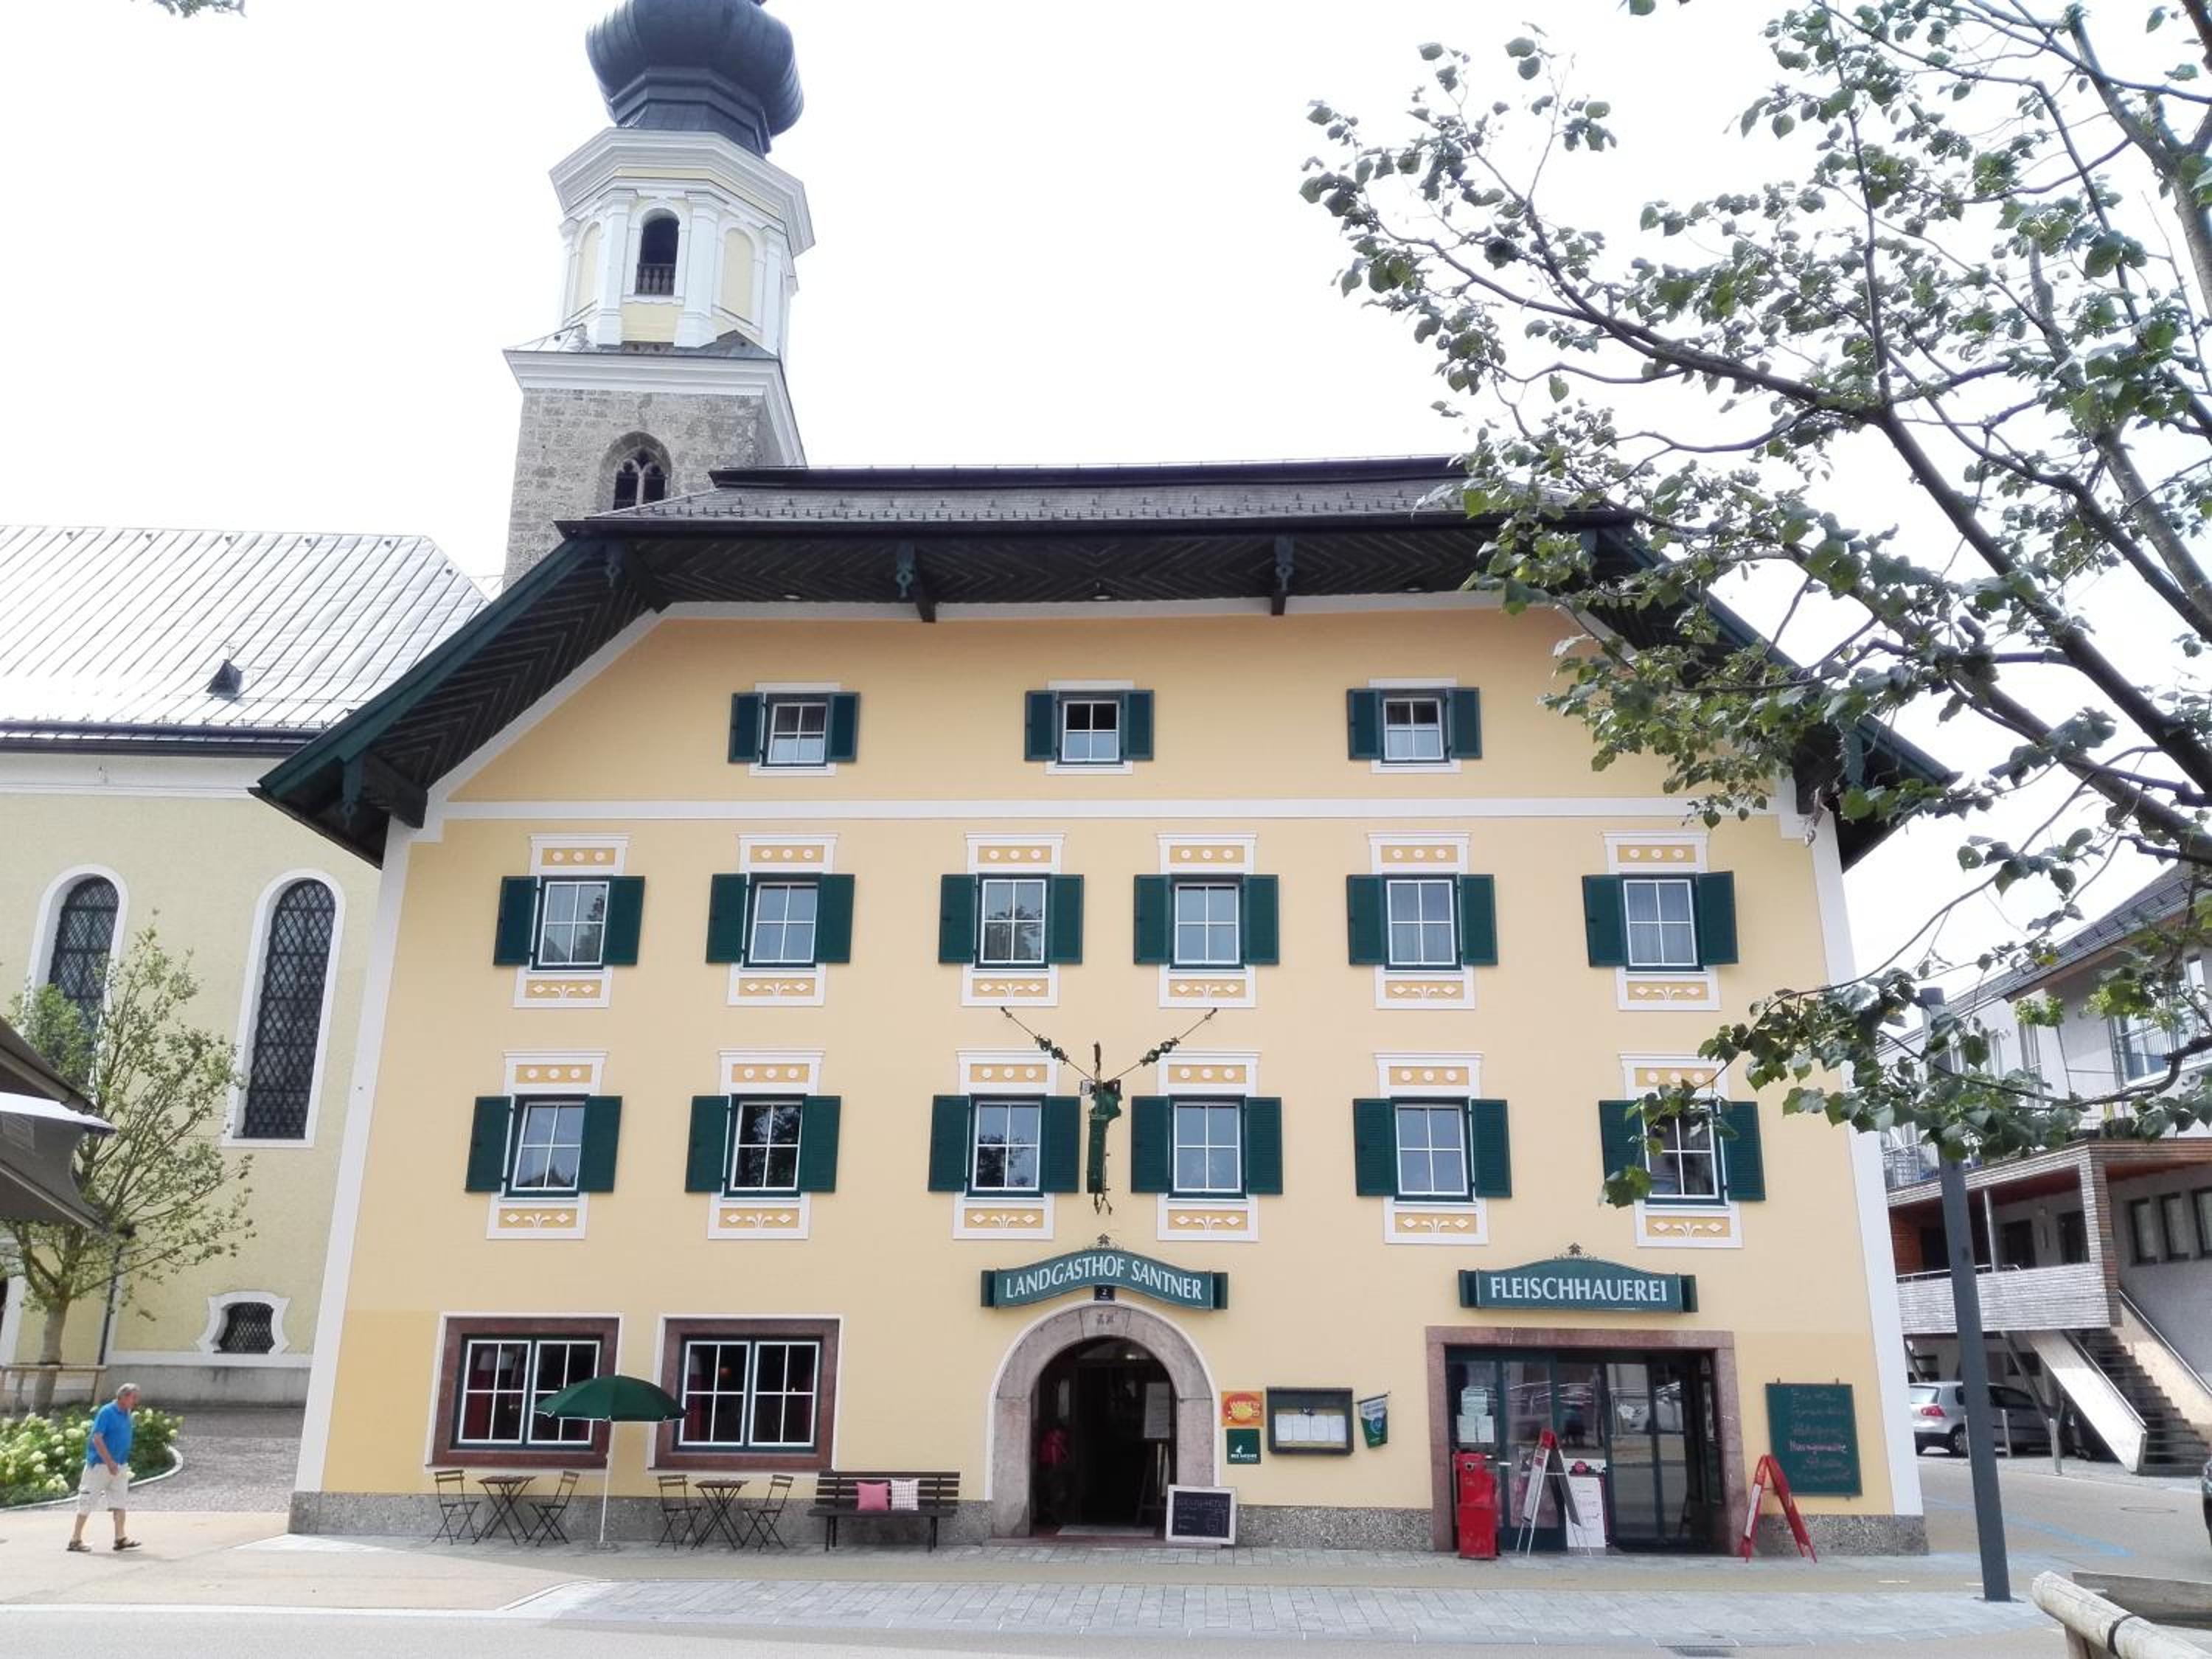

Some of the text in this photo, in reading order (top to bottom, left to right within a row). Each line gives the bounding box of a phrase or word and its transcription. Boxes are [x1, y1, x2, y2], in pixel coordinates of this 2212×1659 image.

[1006, 1255, 1203, 1300] LANDGASTHOF SANTNER
[1489, 1276, 1668, 1302] FLEISCHHAUEREI
